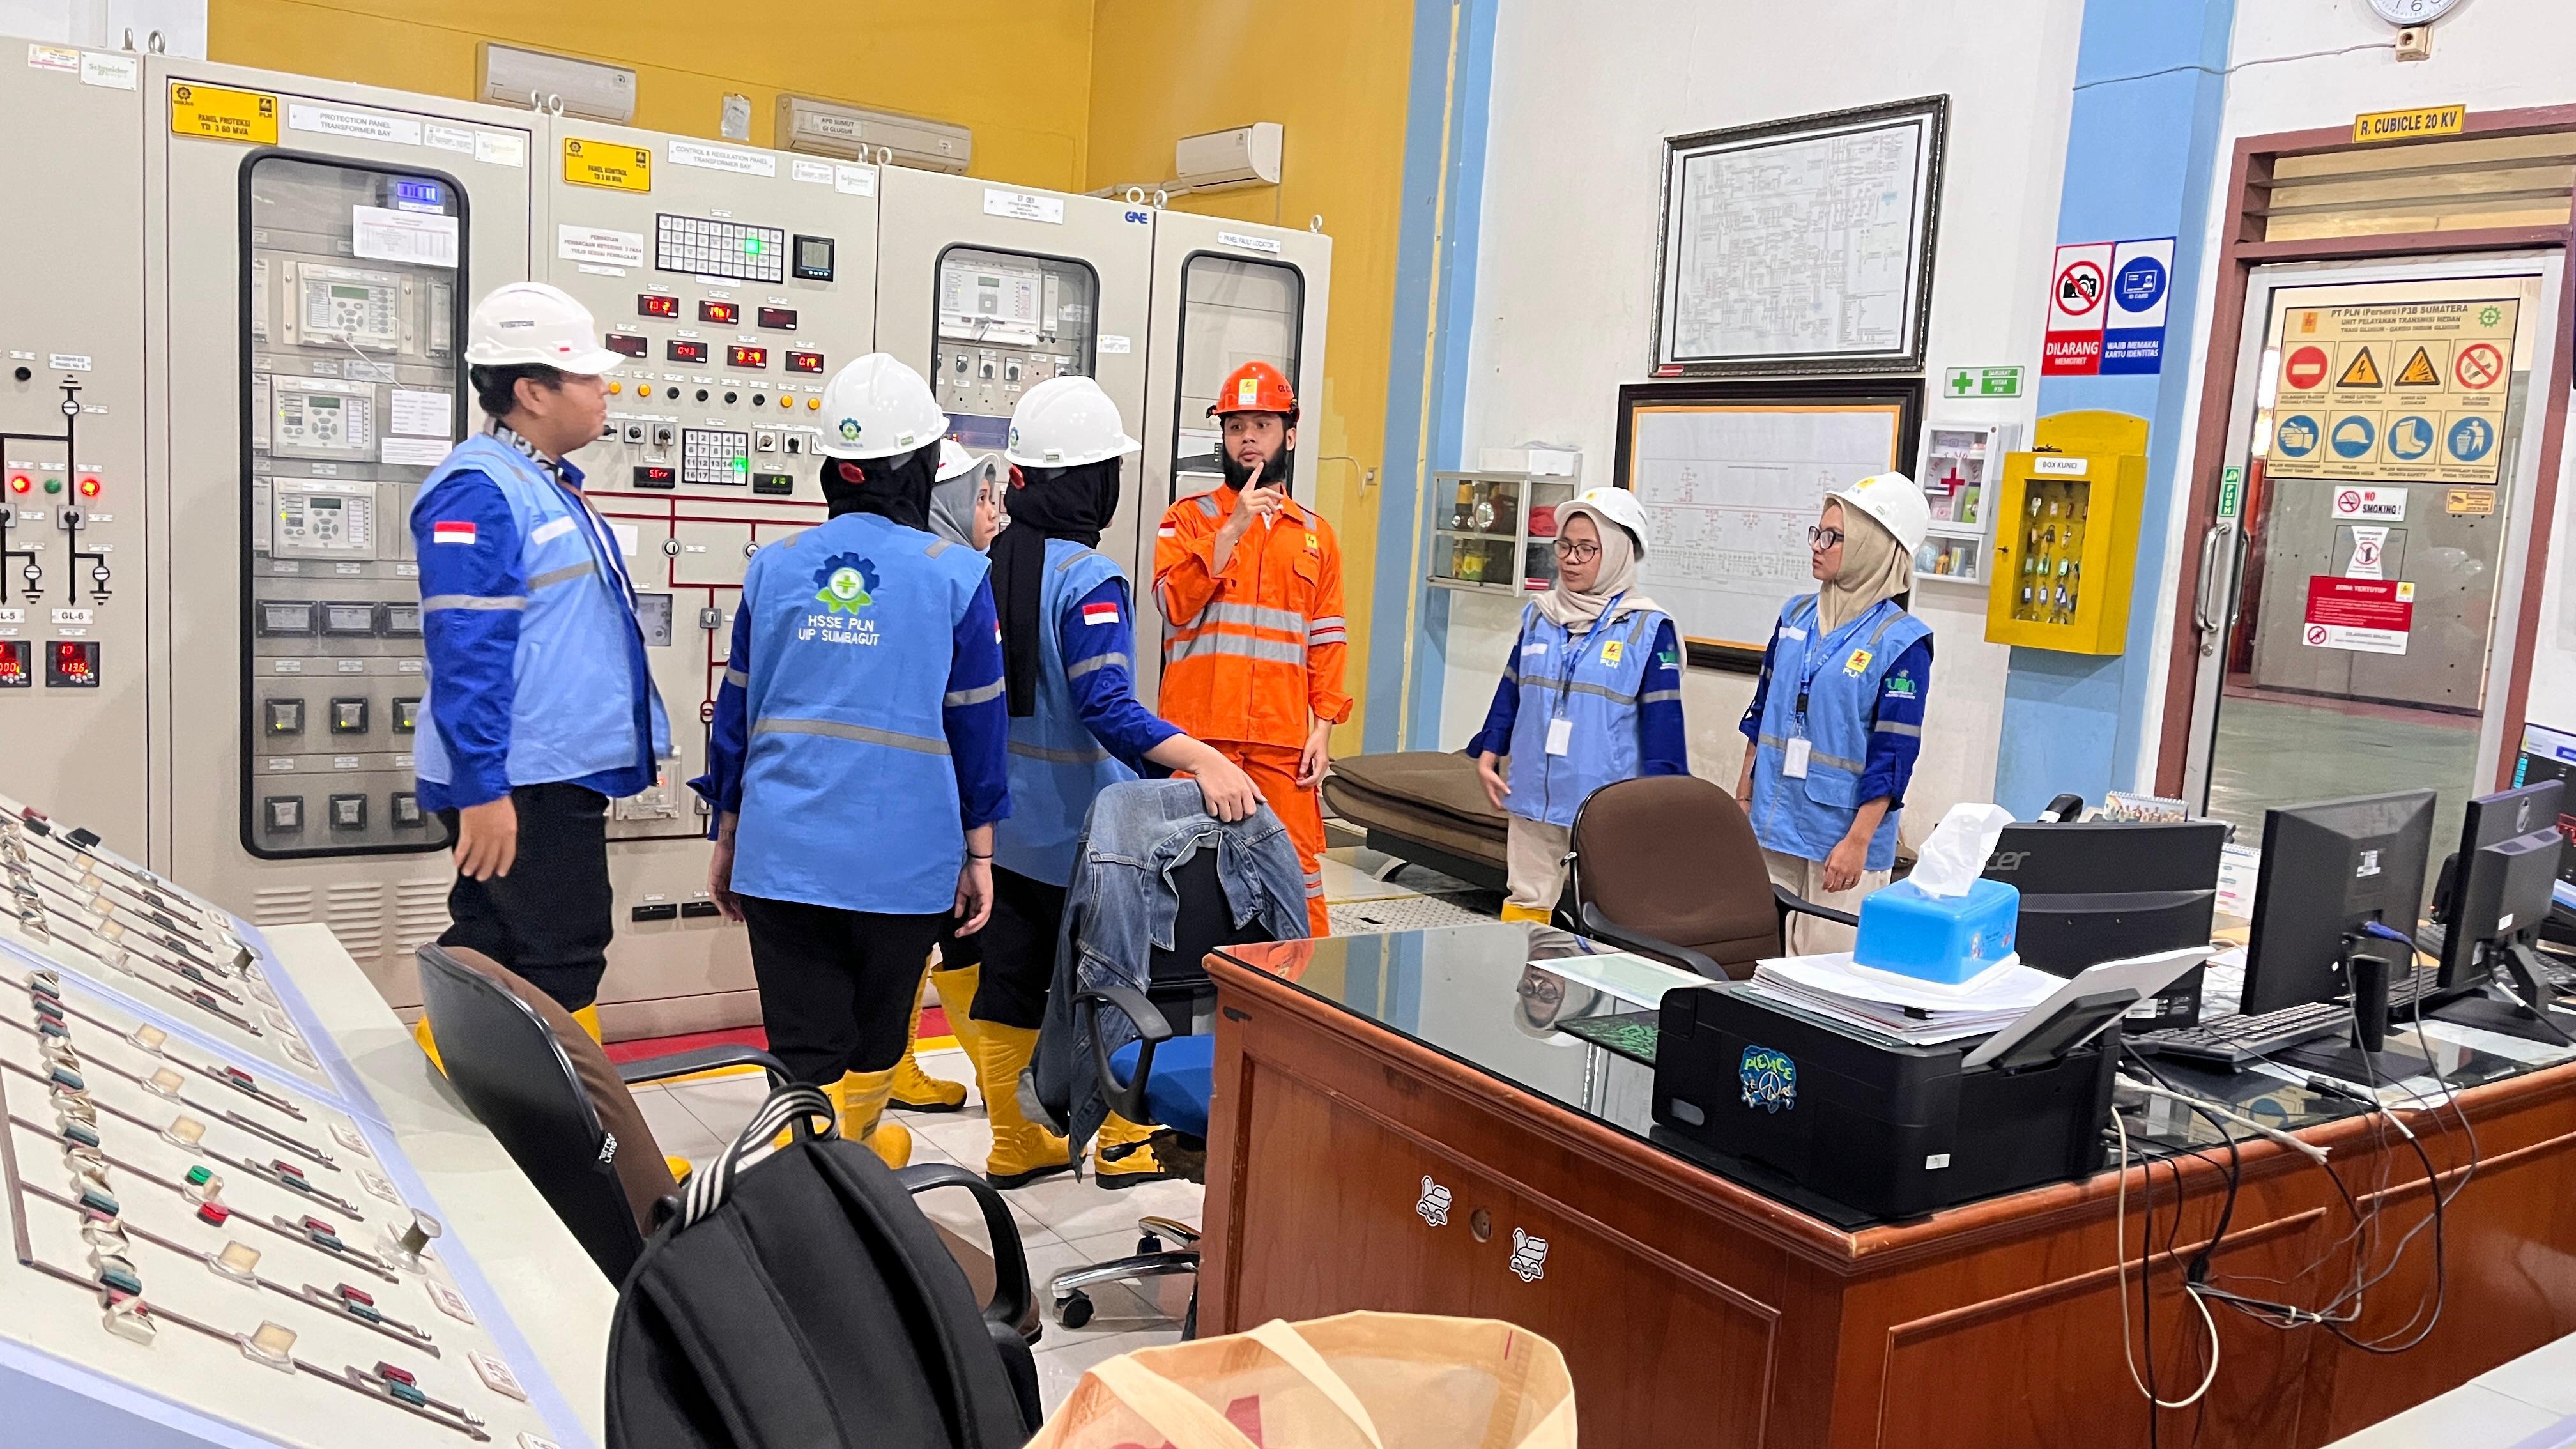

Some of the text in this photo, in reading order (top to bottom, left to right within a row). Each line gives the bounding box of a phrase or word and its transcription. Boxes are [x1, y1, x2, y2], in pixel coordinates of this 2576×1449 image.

[320, 112, 392, 129] PROTECTION PANEL
[2361, 111, 2457, 135] R. CUBICLE 20 KV
[320, 121, 391, 137] TRANSFORMER BAY
[675, 146, 704, 155] CONTROL
[711, 151, 748, 162] REGULATION
[694, 156, 738, 167] TRANSFORMER
[1223, 234, 1238, 243] PANEL
[1253, 240, 1274, 249] LOCATOR
[2420, 305, 2468, 314] SUMATERA
[2046, 341, 2099, 355] DILARANG
[2127, 341, 2159, 349] MEMAKAI
[2105, 349, 2158, 358] KARTU IDENTITAS
[2223, 484, 2234, 514] PUSH
[2365, 491, 2375, 502] NO
[2363, 504, 2396, 514] SMOKING
[808, 615, 874, 632] HSSE PLN
[798, 627, 880, 646] UIP SUMBAGUT
[1600, 659, 1618, 669] PLN
[1985, 852, 2031, 870] cer
